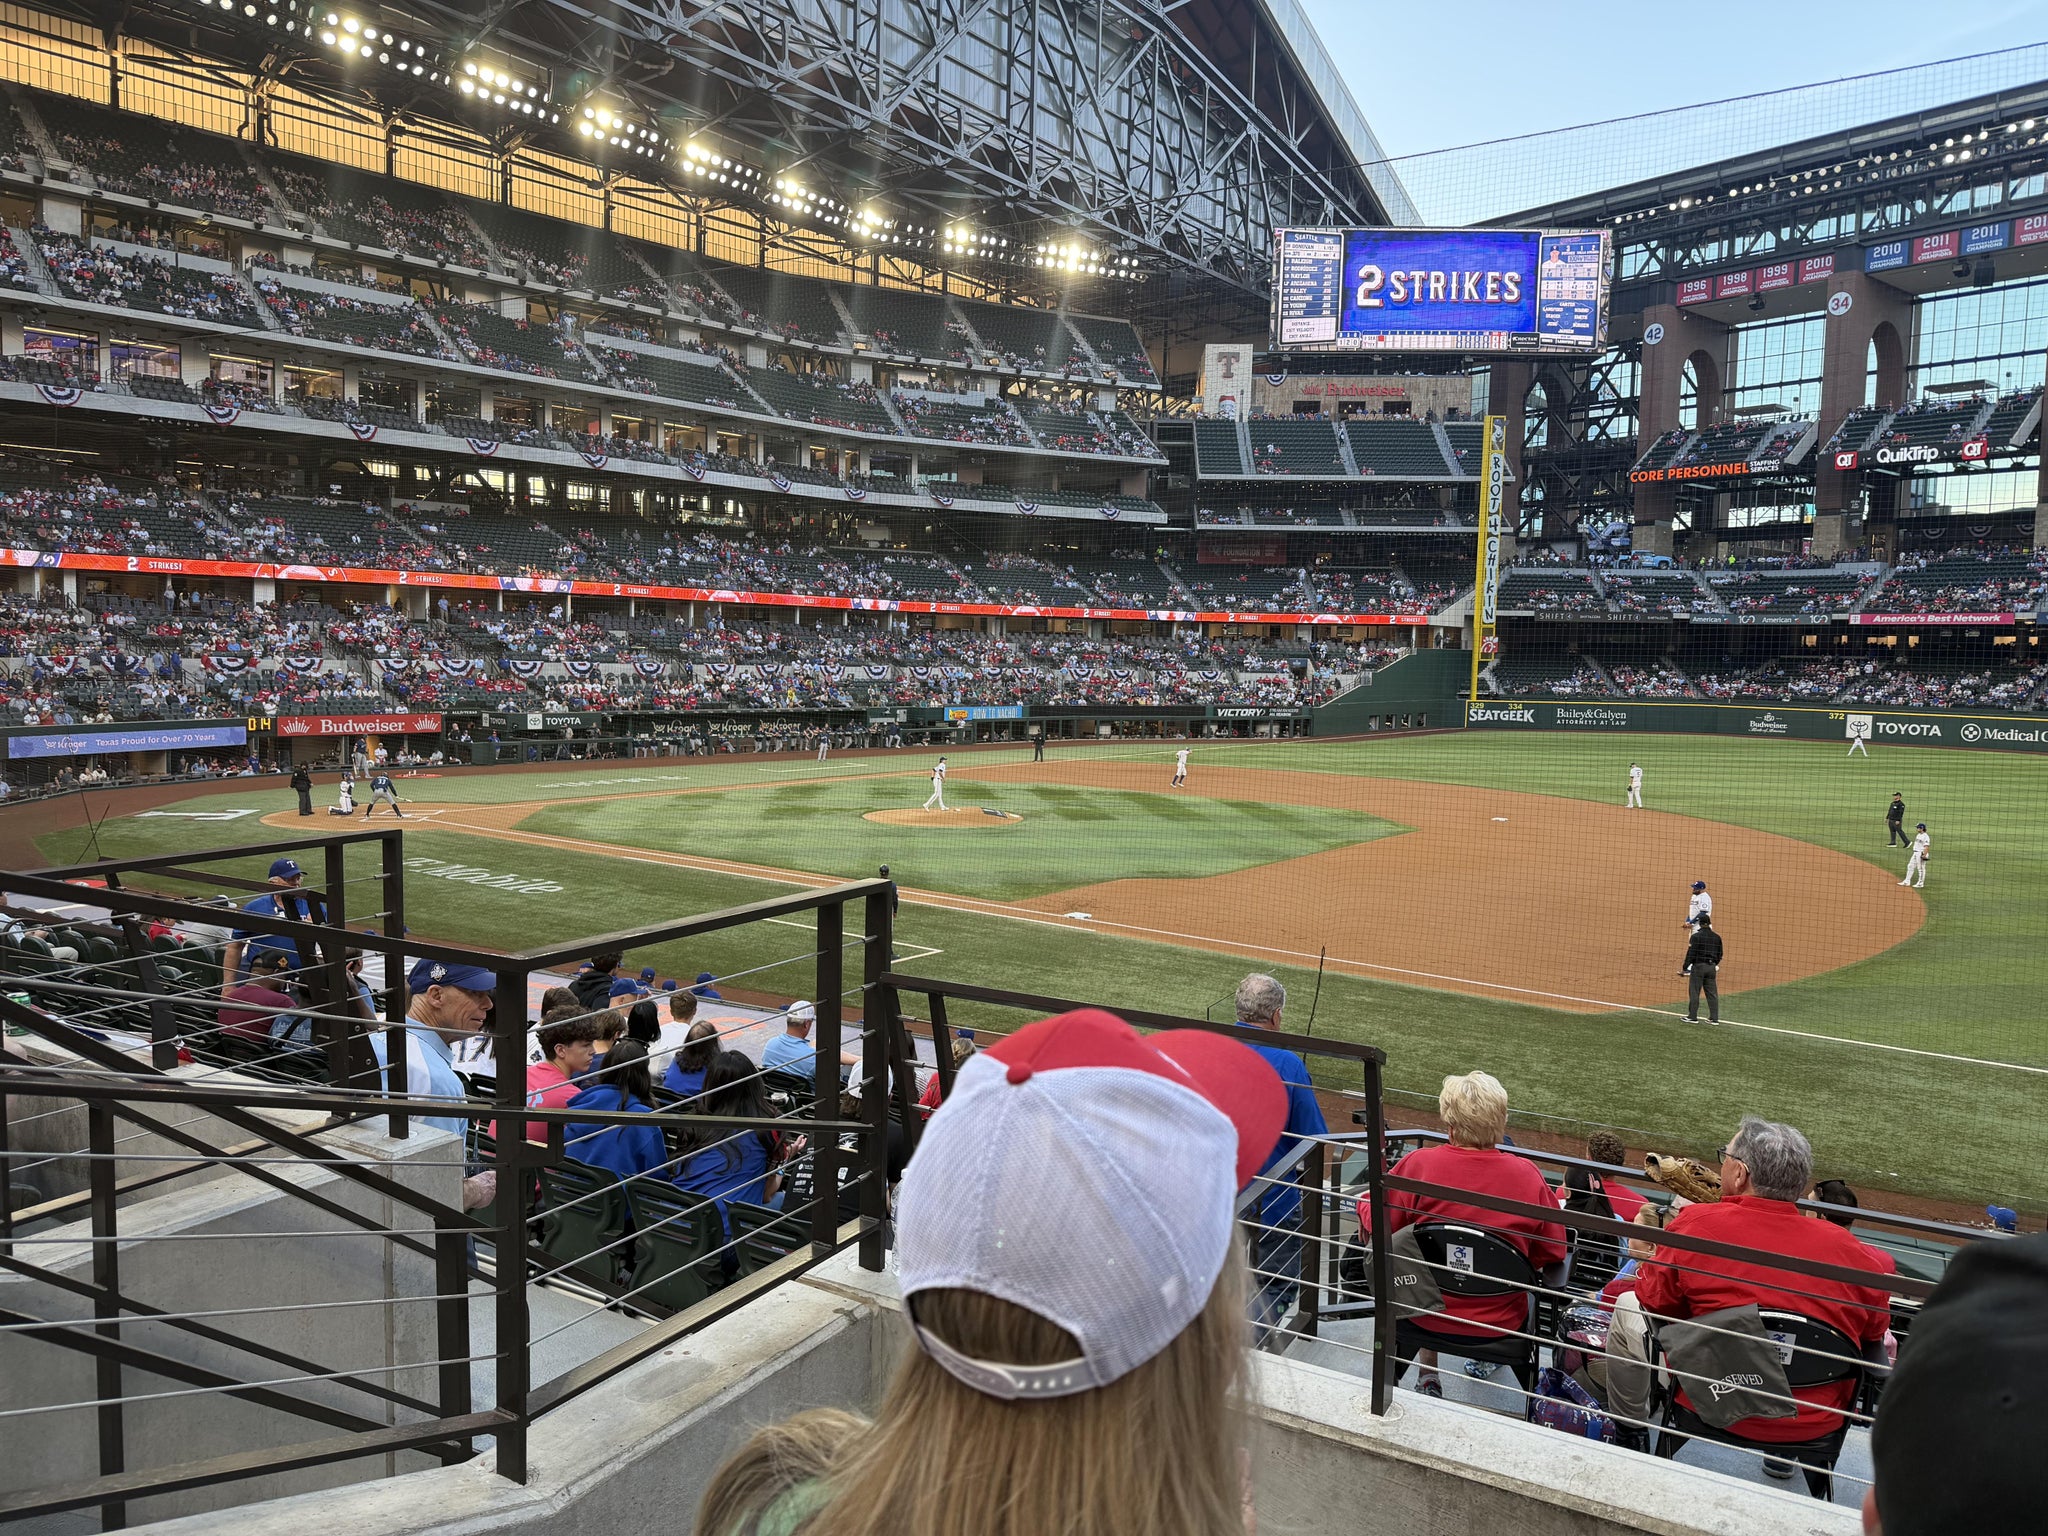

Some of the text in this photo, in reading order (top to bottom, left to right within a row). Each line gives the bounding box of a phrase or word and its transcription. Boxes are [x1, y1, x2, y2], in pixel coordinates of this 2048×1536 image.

[2023, 215, 2048, 230] 201
[1294, 233, 1319, 242] SEATTLE
[1972, 224, 1999, 240] 2011
[1923, 234, 1950, 249] 2011
[1966, 242, 2003, 252] CHAMPIONS
[1873, 243, 1901, 258] 2010
[1917, 250, 1953, 261] CHAMPIONS
[1806, 256, 1833, 270] 2010
[1869, 259, 1903, 270] CHAMPIONS
[1763, 264, 1788, 278] 1999
[1356, 264, 1384, 307] 2
[1389, 270, 1522, 303] STRIKES
[1723, 272, 1748, 286] 1998
[1760, 280, 1790, 289] CHAMPIONS
[1683, 280, 1707, 294] 1996
[1720, 287, 1749, 297] CHAMPIONS
[1680, 294, 1708, 304] CHAMPIONS
[1831, 296, 1850, 311] 34
[1646, 327, 1661, 341] 42
[1217, 351, 1241, 379] T
[1326, 382, 1406, 397] Budweiser
[1876, 445, 1939, 464] QuikTrip
[1963, 442, 1984, 457] QT
[1750, 459, 1781, 467] STAFFING
[1836, 453, 1854, 468] QT
[1630, 462, 1749, 483] CORE PERSONNEL
[1750, 464, 1779, 473] SERVICES
[1489, 517, 1499, 532] 4
[127, 556, 182, 571] 2 STRIKES!
[399, 571, 442, 584] 2 STRIKES!
[1539, 612, 1565, 620] SHIFT
[1607, 613, 1633, 621] SHIFT
[1692, 615, 1722, 623] American
[1762, 616, 1792, 624] American
[1873, 614, 1925, 623] America's
[1928, 614, 1951, 623] Best
[1953, 614, 2001, 623] Network
[1217, 708, 1263, 717] VICTORY
[1469, 709, 1535, 723] SEATGEEK
[1556, 708, 1627, 721] Bailey&Galyen
[1828, 712, 1845, 720] 372
[320, 718, 406, 734] Budweiser
[545, 717, 582, 726] TOYOTA
[721, 719, 752, 733] Kroger
[1876, 722, 1942, 737] TOYOTA
[1984, 728, 2039, 742] Medical
[95, 738, 119, 746] Texas
[121, 736, 145, 746] Proud
[148, 735, 160, 744] for
[161, 734, 181, 744] Over
[183, 734, 193, 742] 70
[194, 733, 216, 742] Years
[286, 860, 296, 868] T
[1708, 1373, 1764, 1402] RESERVED
